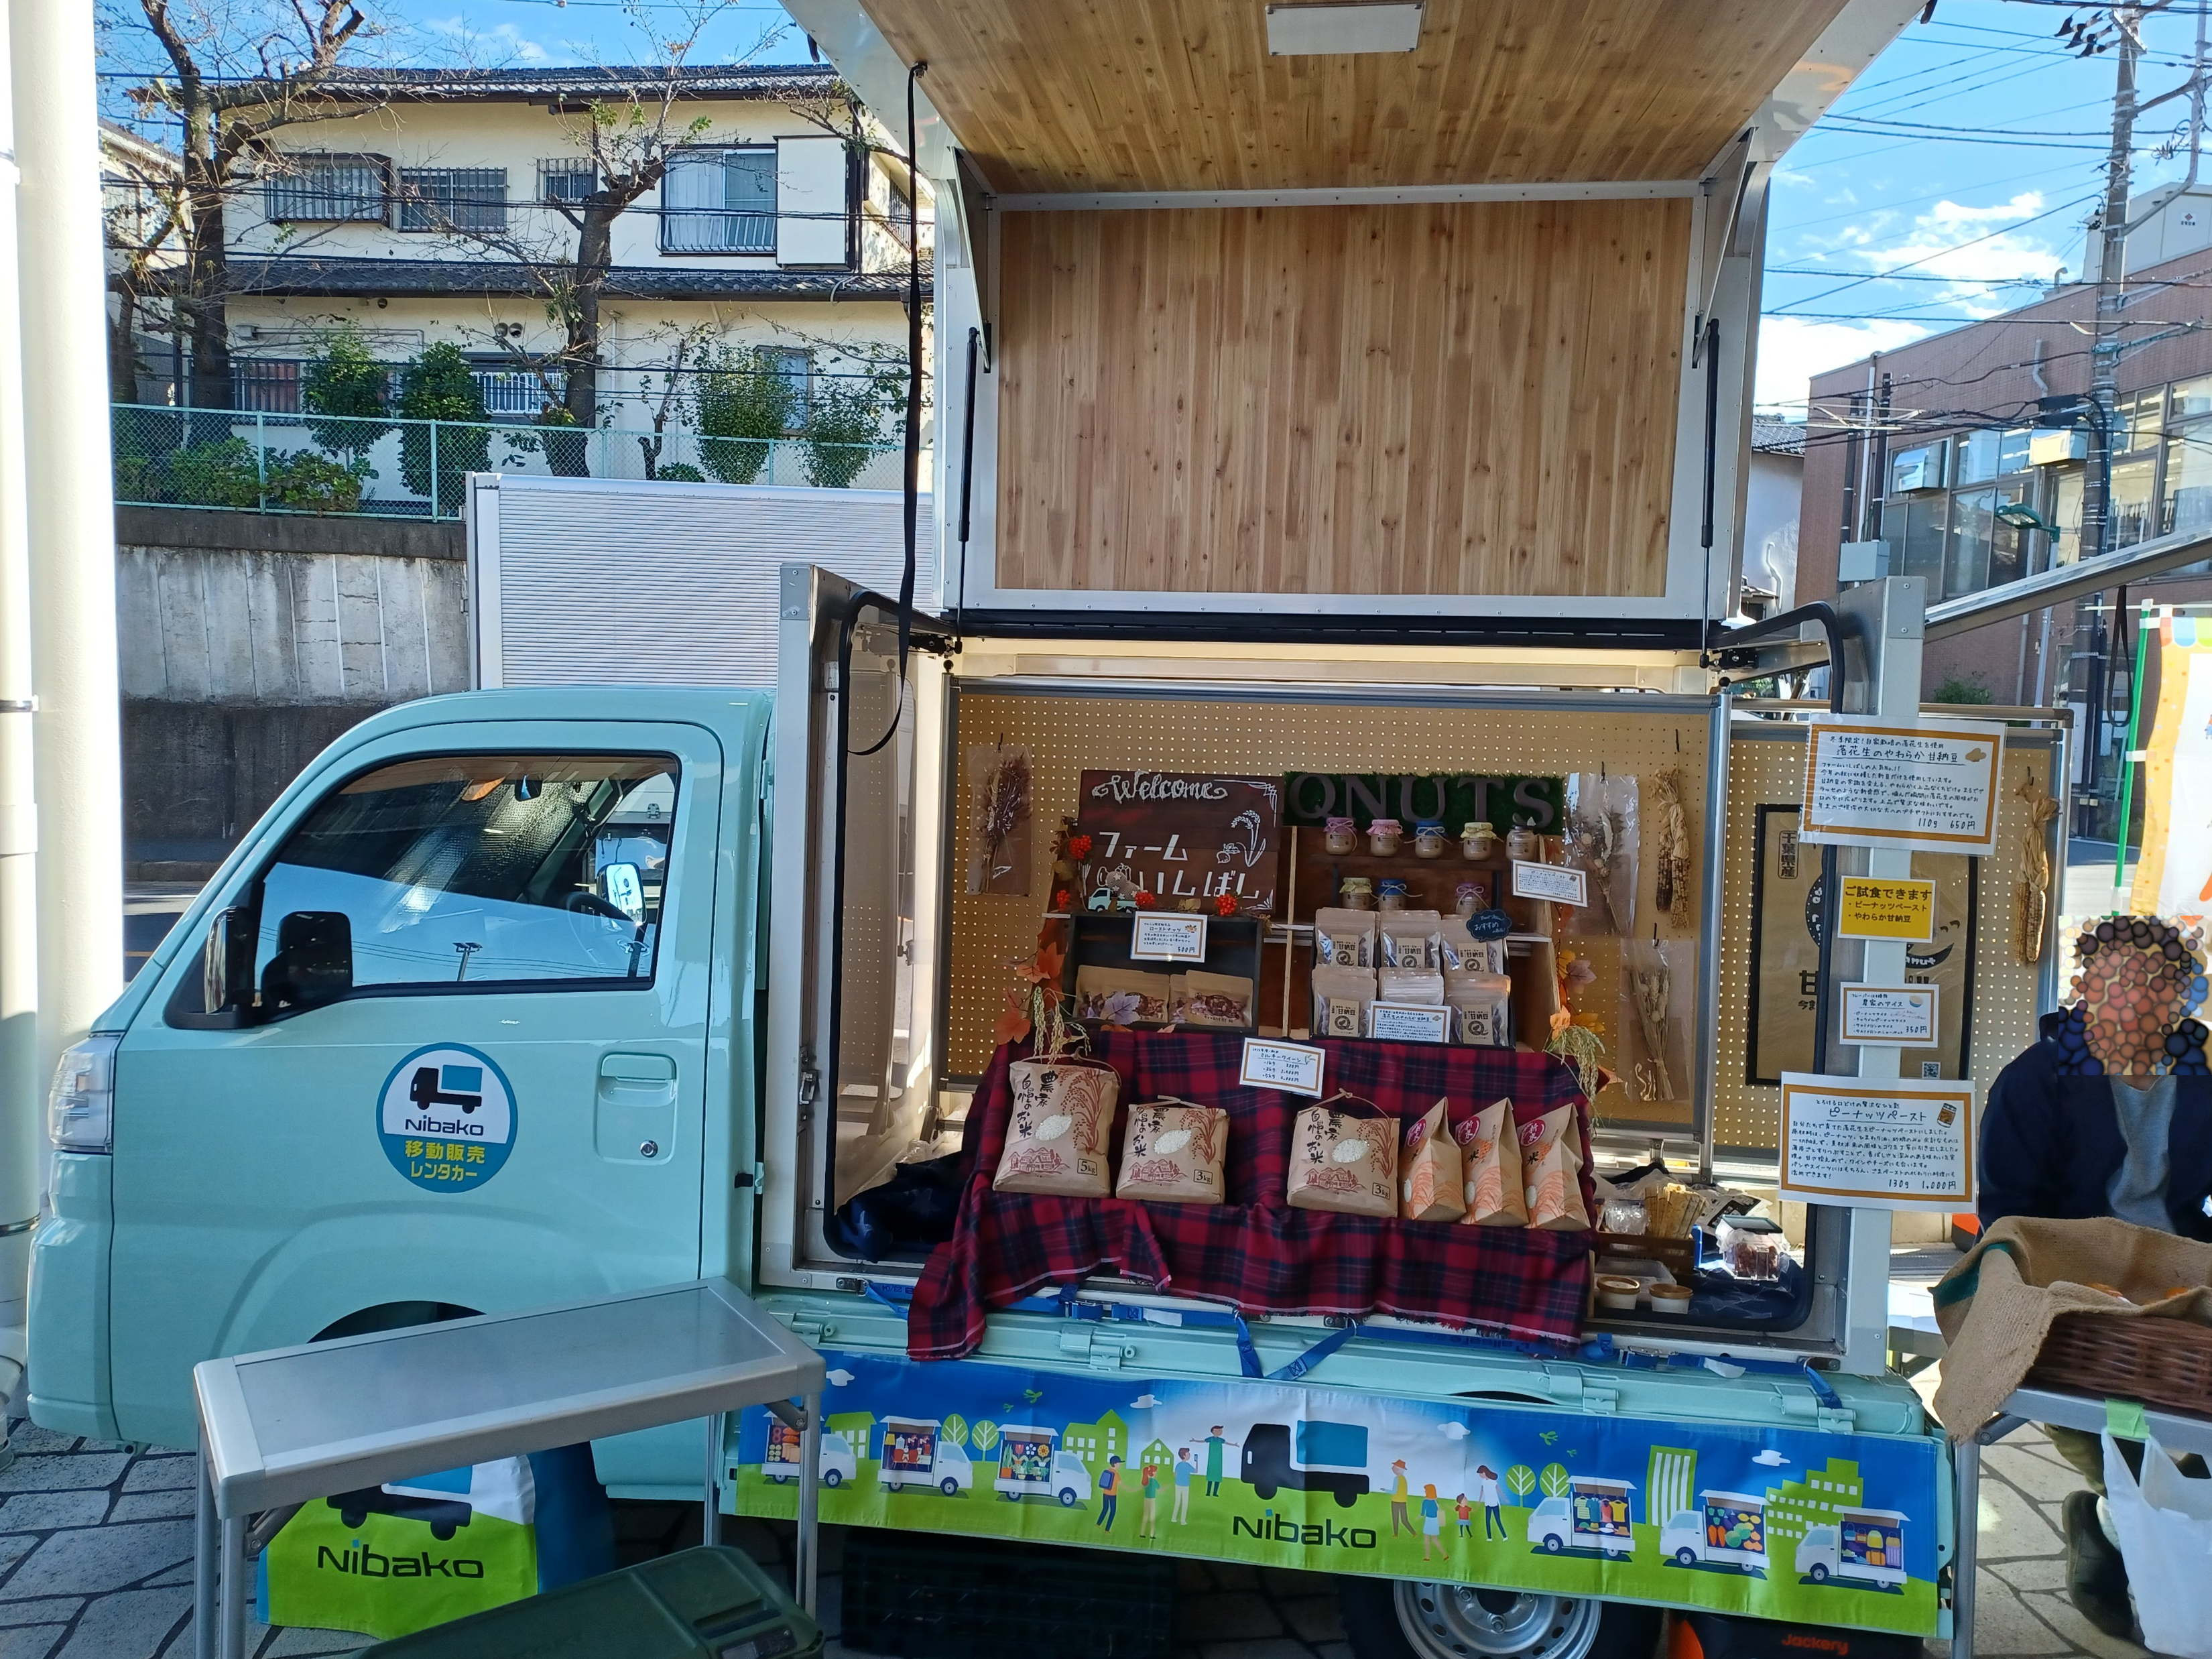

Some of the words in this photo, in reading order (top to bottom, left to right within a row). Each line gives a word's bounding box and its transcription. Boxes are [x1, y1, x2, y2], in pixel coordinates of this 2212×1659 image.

[1837, 745, 1958, 762] 落花生のやわらか甘納豆
[1092, 770, 1228, 804] Welcome
[1288, 772, 1554, 828] QNUTS
[1918, 818, 1938, 829] 110g
[1950, 820, 1975, 831] 650円
[1099, 832, 1188, 861] ファーム
[1781, 832, 1796, 877] 千葉県産
[1139, 870, 1259, 899] いしばし
[1845, 885, 1932, 901] ご試食できます
[1474, 922, 1499, 931] おすすめ
[1799, 970, 1819, 995] 甘
[1798, 1000, 1815, 1011] 今ま
[1862, 999, 1903, 1007] 農家のアイス
[1261, 1053, 1301, 1062] ミルキークイーン
[1035, 1070, 1058, 1107] 農家
[1017, 1073, 1033, 1138] 自慢のお米
[1829, 1107, 1927, 1121] ピーナッツペースト
[405, 1115, 484, 1136] Nibako
[1307, 1108, 1324, 1164] 自慢のお米
[405, 1140, 485, 1164] 移動販売
[411, 1162, 478, 1181] レンタカー
[1081, 1161, 1095, 1173] 5kg
[1196, 1172, 1211, 1182] 3kg
[1375, 1186, 1388, 1197] 3kg
[1888, 1179, 1909, 1188] 130g
[1922, 1180, 1957, 1190] 1,000円
[1233, 1509, 1376, 1549] Nibako
[317, 1539, 484, 1579] Nibako
[1781, 1634, 1849, 1656] Jackery
